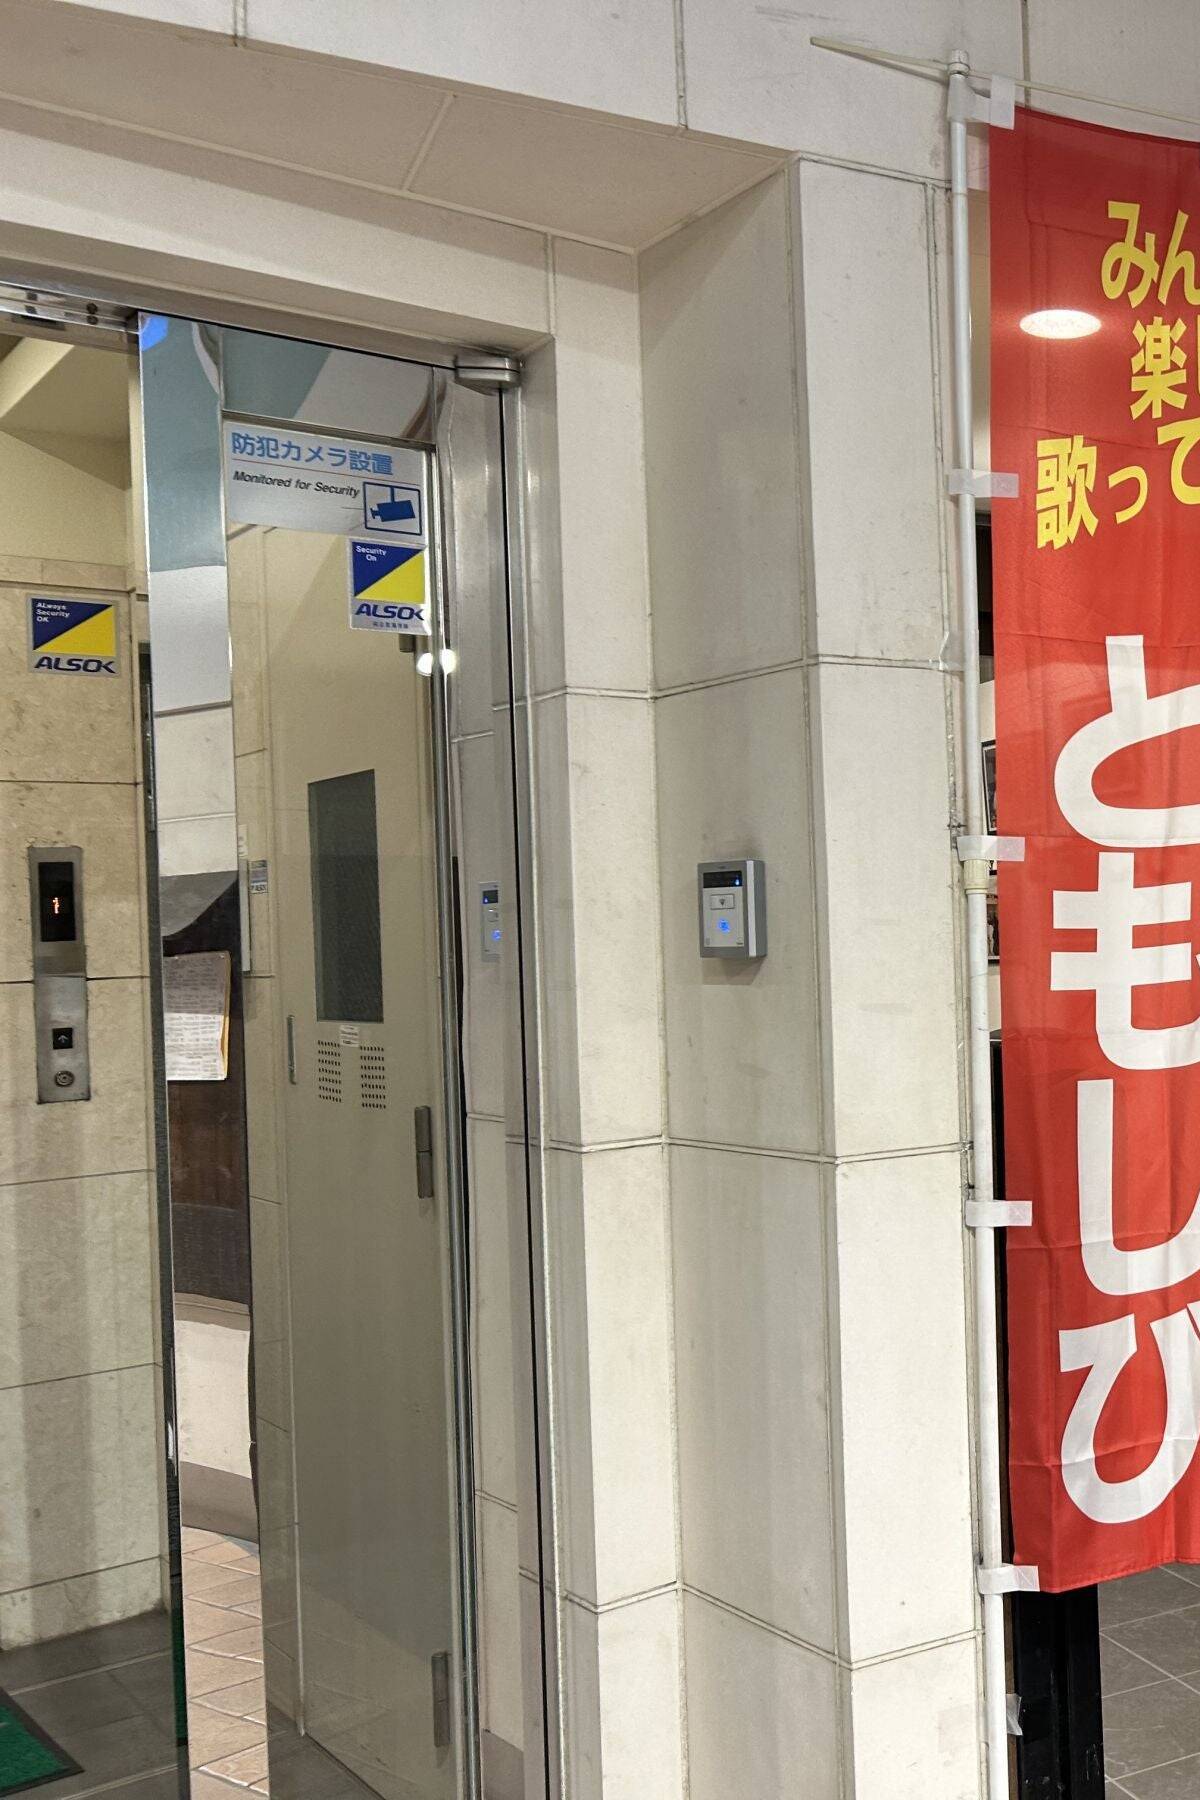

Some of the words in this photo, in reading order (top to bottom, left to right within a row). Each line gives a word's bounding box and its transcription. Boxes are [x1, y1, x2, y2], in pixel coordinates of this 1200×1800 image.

[231, 431, 393, 476] 防犯カメラ設置
[233, 471, 292, 488] Monitored
[295, 476, 312, 490] for
[315, 482, 360, 498] Security
[356, 545, 387, 556] Security
[36, 609, 70, 618] Security
[355, 603, 424, 621] ALSOK
[34, 656, 116, 674] ALSOK
